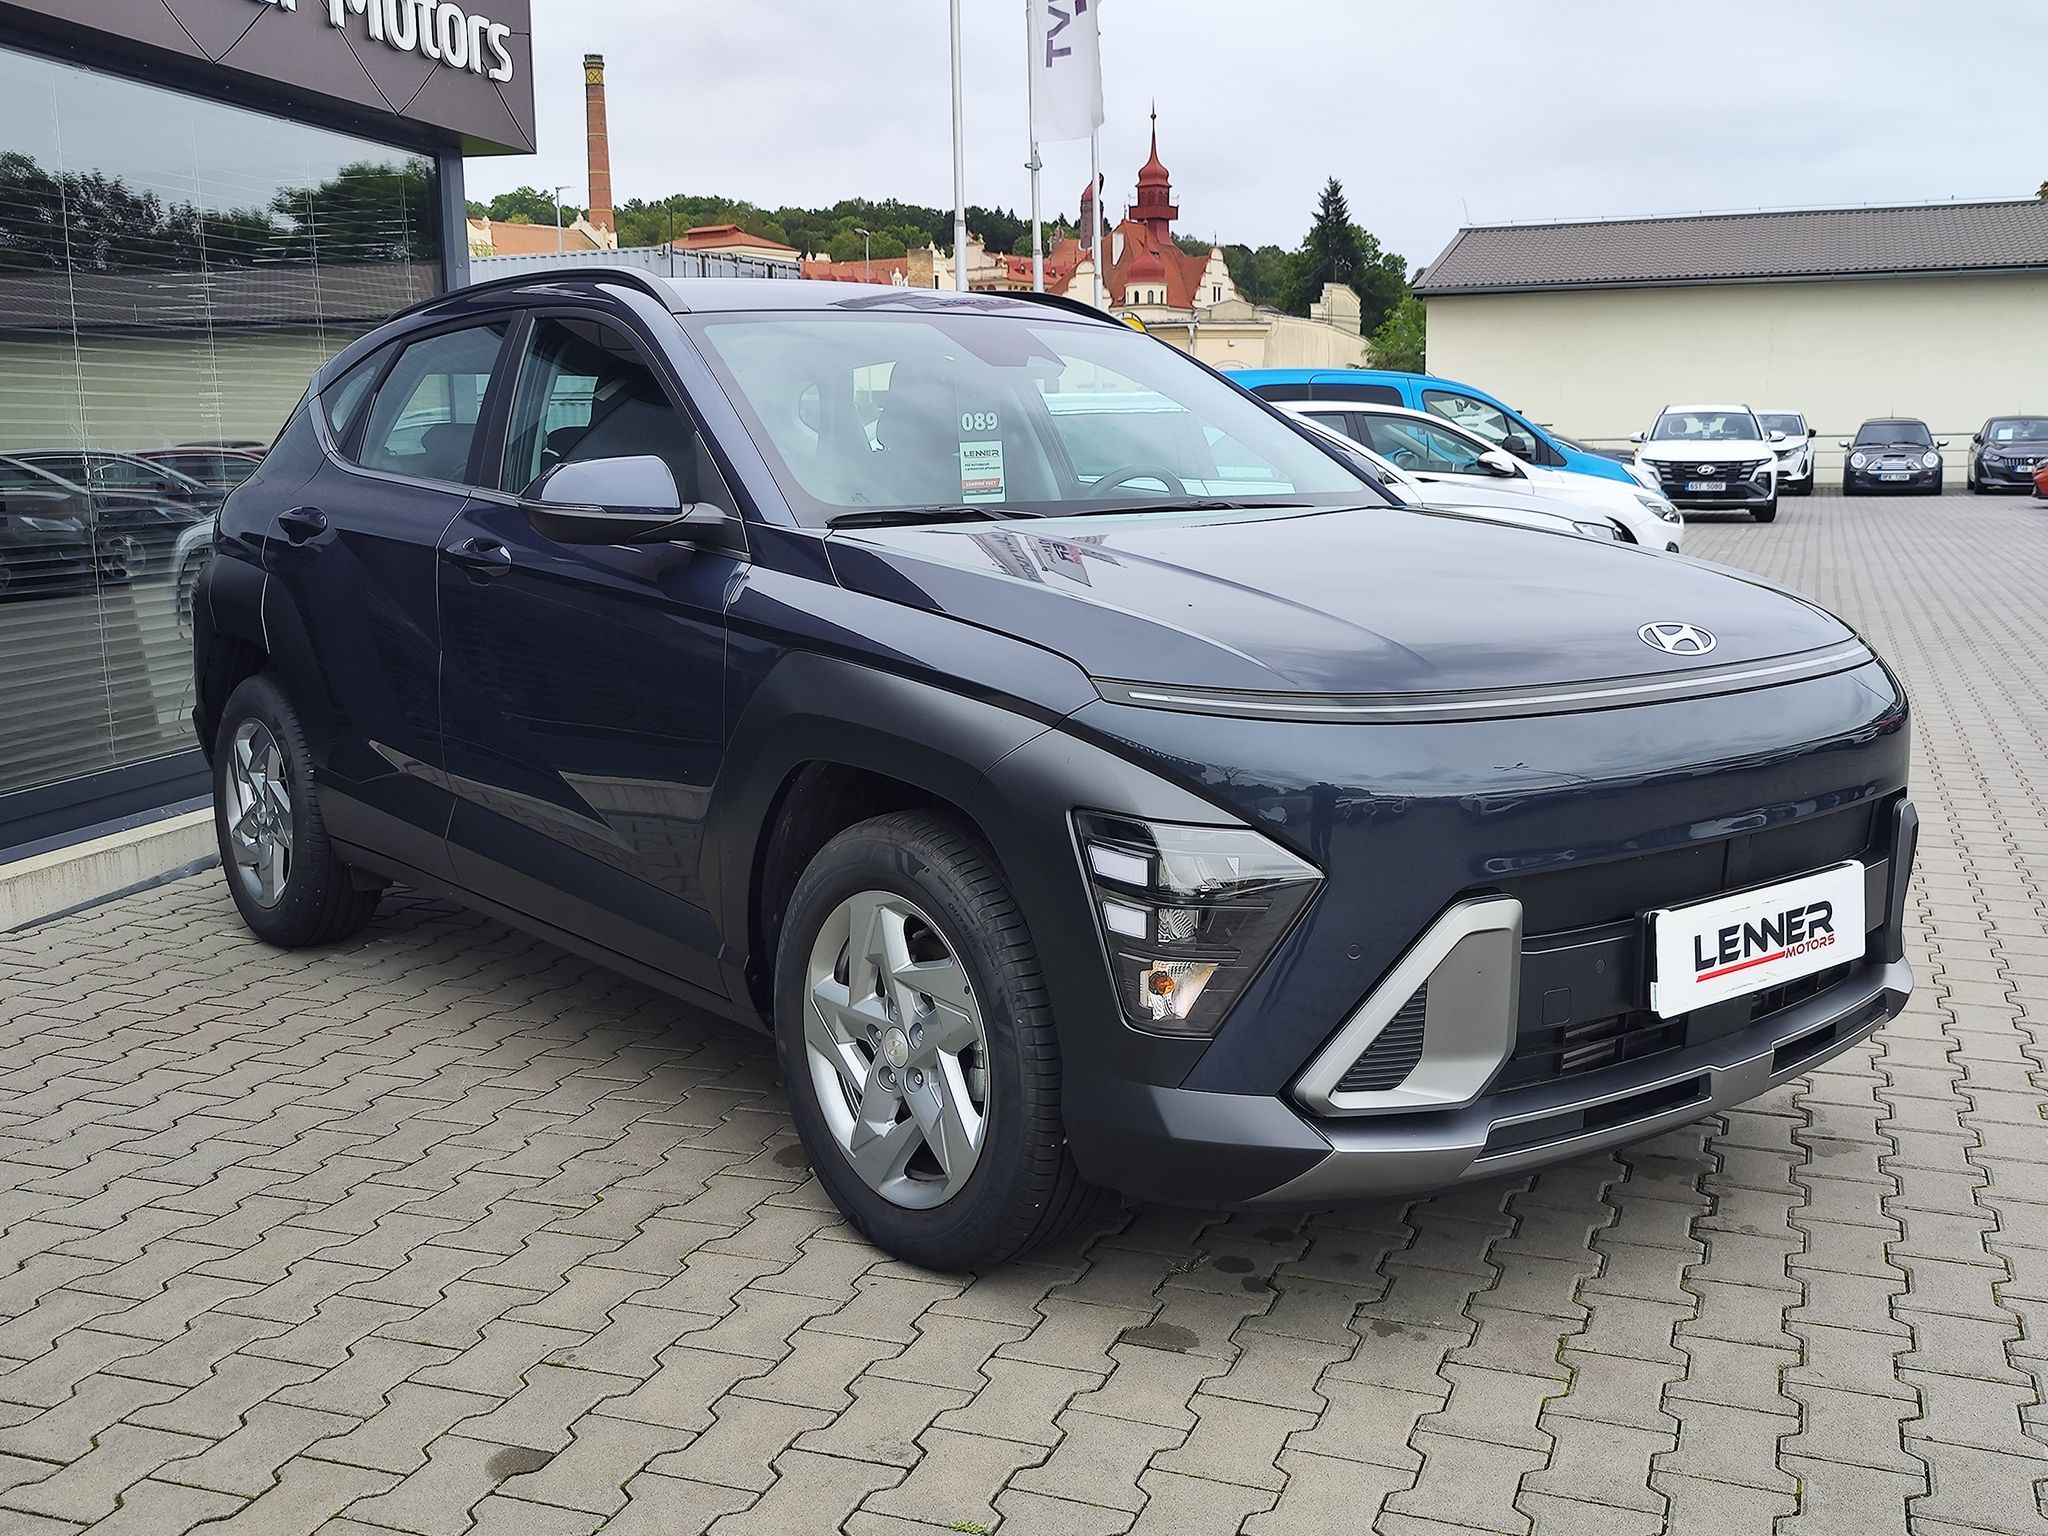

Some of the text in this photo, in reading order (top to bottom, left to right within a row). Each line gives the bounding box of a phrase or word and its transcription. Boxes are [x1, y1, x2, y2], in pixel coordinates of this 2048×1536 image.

[961, 411, 999, 431] 089
[963, 449, 1000, 458] LENNER
[1693, 900, 1834, 972] LENNER
[1785, 934, 1836, 959] MOTORS
